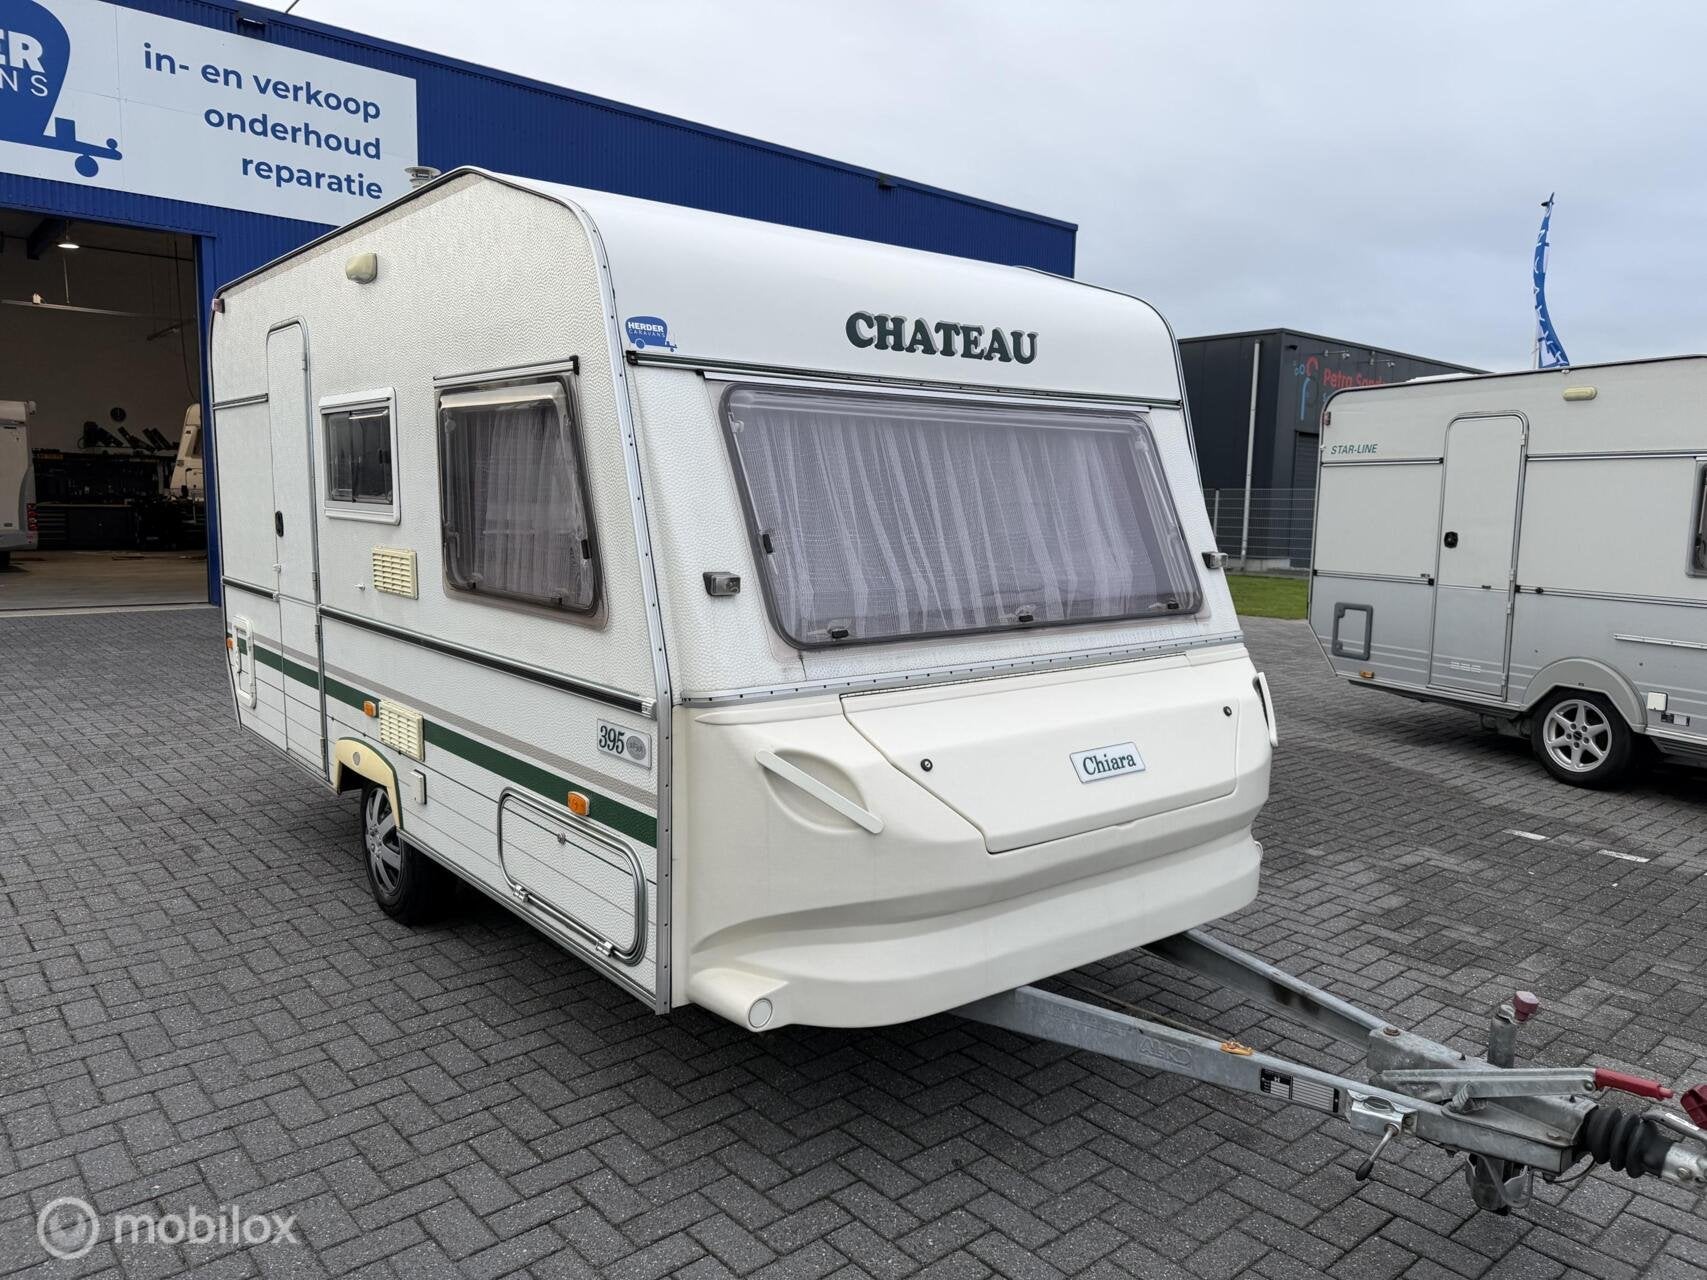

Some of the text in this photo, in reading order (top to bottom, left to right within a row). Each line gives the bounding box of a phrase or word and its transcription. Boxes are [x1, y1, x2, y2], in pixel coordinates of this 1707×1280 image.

[143, 42, 381, 122] in- en verkoop
[204, 107, 381, 160] onderhoud
[242, 157, 383, 200] reparatie
[628, 321, 665, 333] HERDER
[628, 328, 666, 338] CARAVANS
[845, 311, 1038, 365] CHATEAU
[1330, 443, 1378, 455] STAR-LINE
[599, 725, 625, 755] 395
[1082, 753, 1137, 775] Chiara
